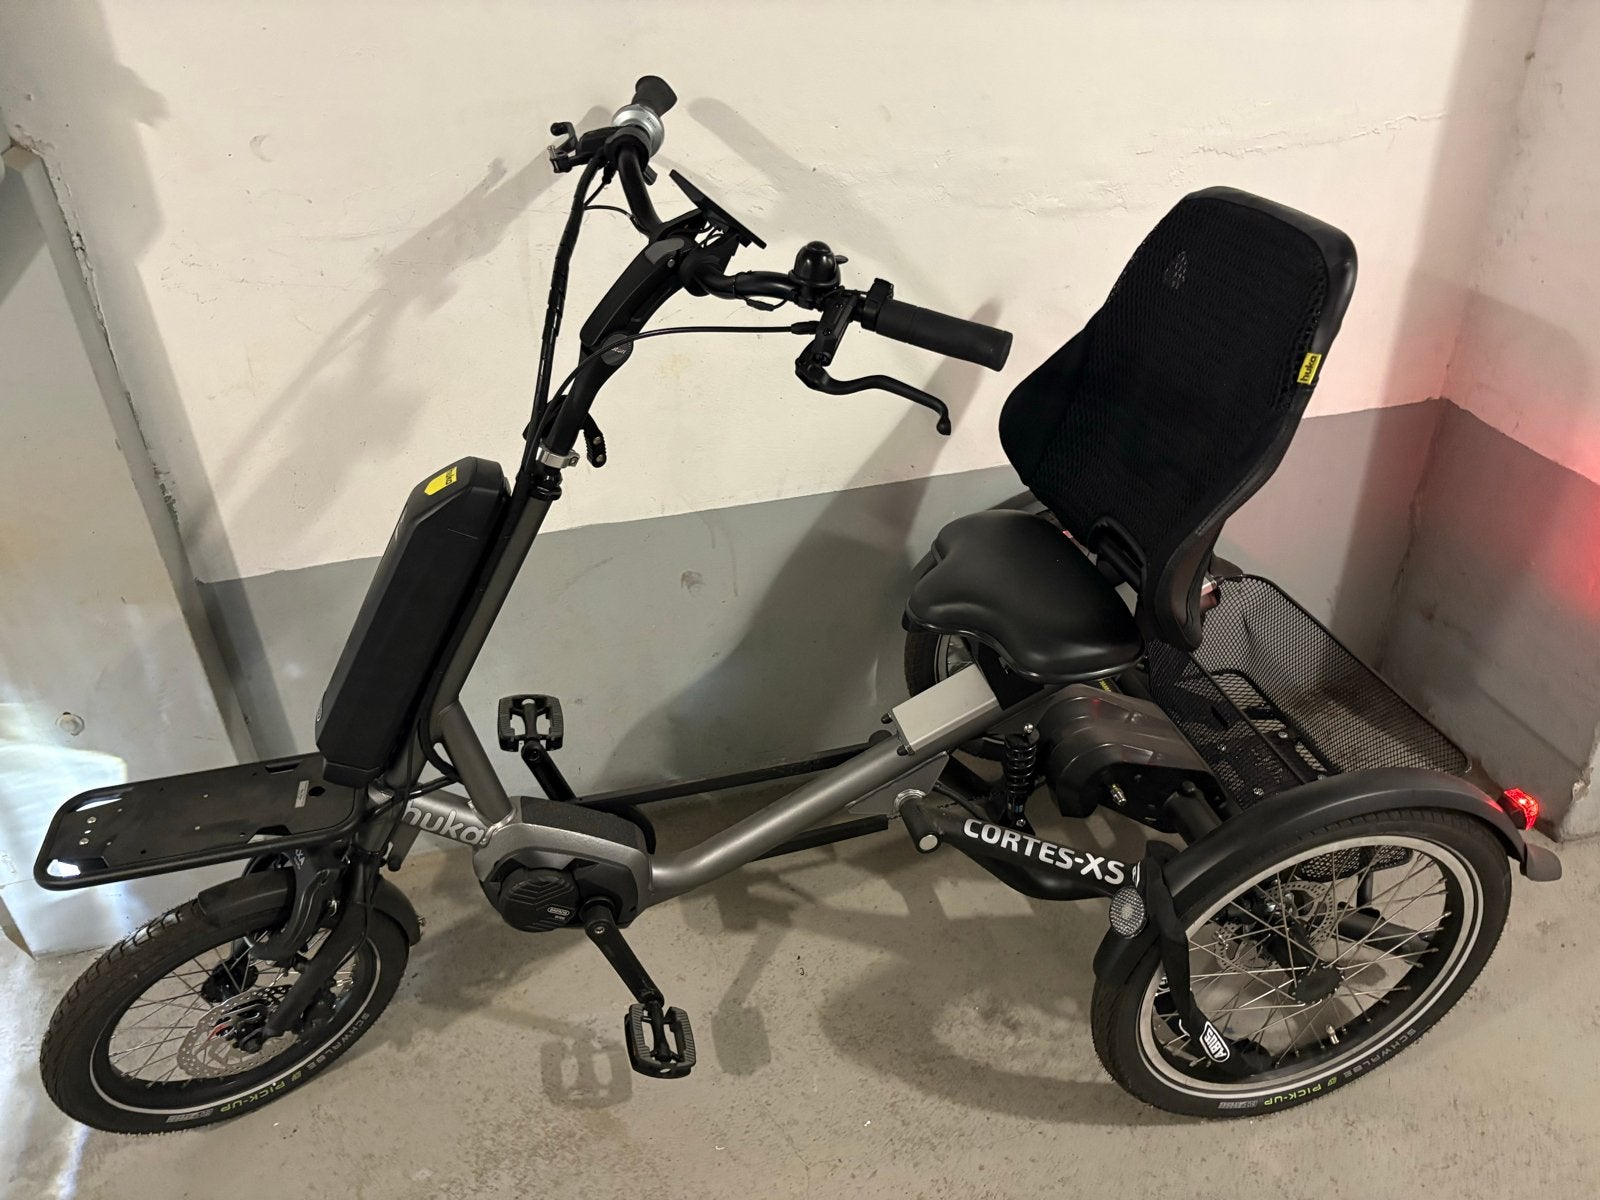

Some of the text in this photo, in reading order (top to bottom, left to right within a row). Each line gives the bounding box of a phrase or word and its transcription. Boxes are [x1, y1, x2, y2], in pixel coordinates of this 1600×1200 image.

[1300, 355, 1317, 382] huka
[401, 799, 484, 845] huka
[963, 818, 1125, 885] CORTES-XS
[220, 1012, 370, 1113] SCHWALBE PICK-UP
[1203, 1027, 1227, 1059] ABUS
[1263, 1027, 1417, 1106] SCHWALBE PICK-UP
